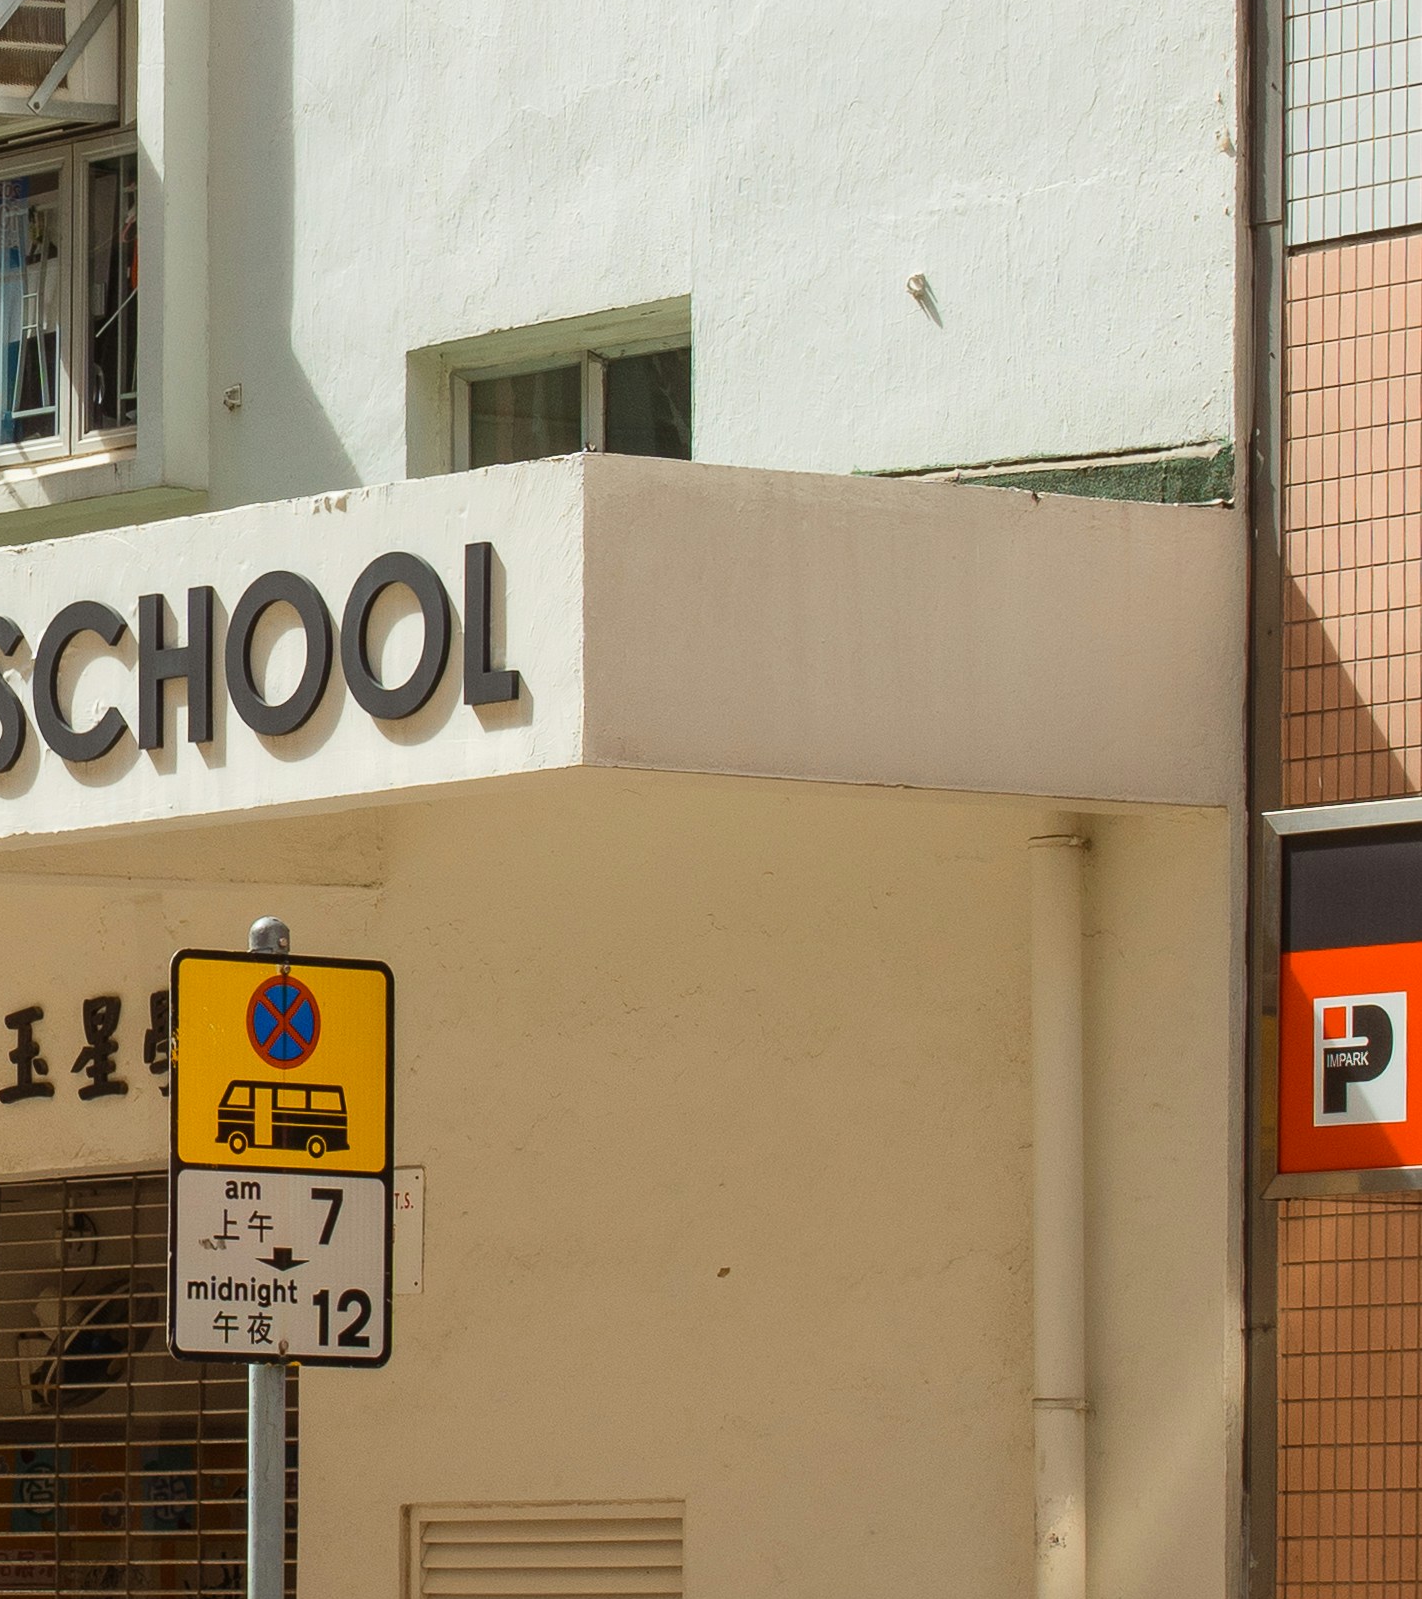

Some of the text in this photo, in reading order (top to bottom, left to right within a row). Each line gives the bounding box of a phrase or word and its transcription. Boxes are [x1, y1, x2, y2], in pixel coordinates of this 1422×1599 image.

[1326, 1050, 1369, 1068] IMPARK
[225, 1179, 262, 1200] am
[213, 1208, 274, 1243] 上午
[311, 1187, 343, 1246] 7
[187, 1275, 298, 1307] midnight
[212, 1310, 274, 1344] 午夜
[312, 1288, 372, 1348] 12
